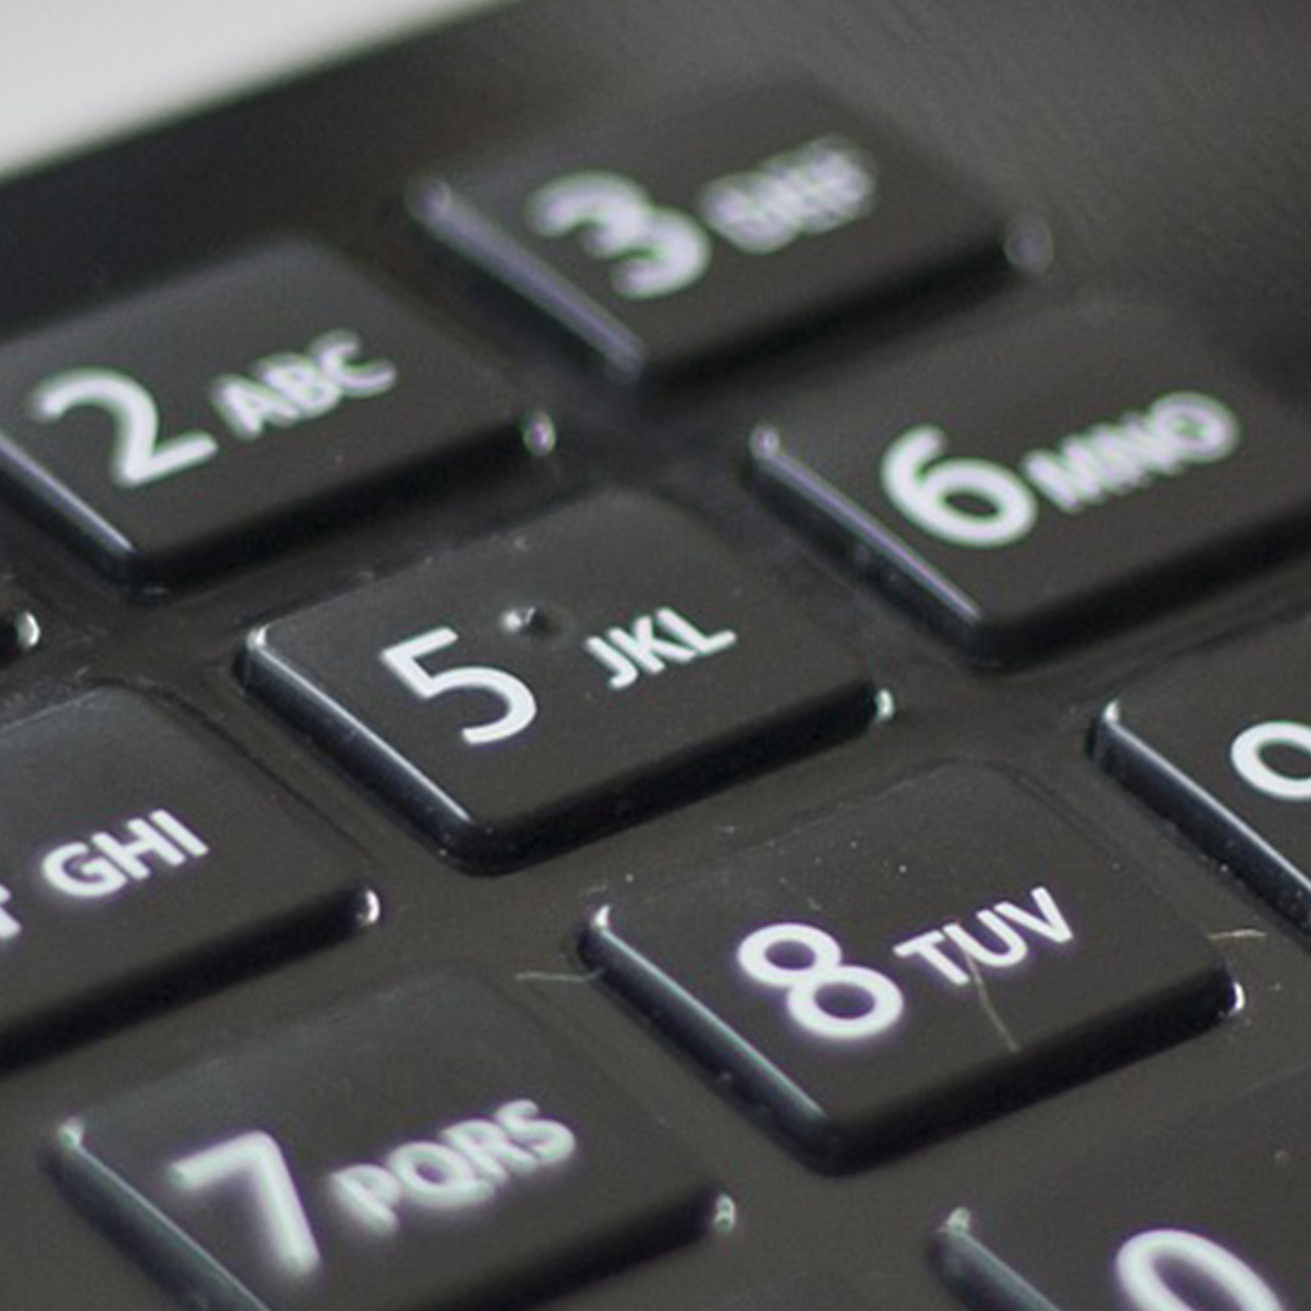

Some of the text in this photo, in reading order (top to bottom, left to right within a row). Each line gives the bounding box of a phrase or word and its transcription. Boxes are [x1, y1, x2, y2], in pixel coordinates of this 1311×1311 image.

[536, 173, 710, 297] 3
[35, 333, 396, 486] 2 ABC
[881, 393, 1238, 547] 6 MNO
[380, 607, 737, 745] 5 JKL
[39, 808, 209, 900] GHI
[735, 885, 1075, 1043] 8 TUV
[168, 1098, 577, 1276] 7 PQRS
